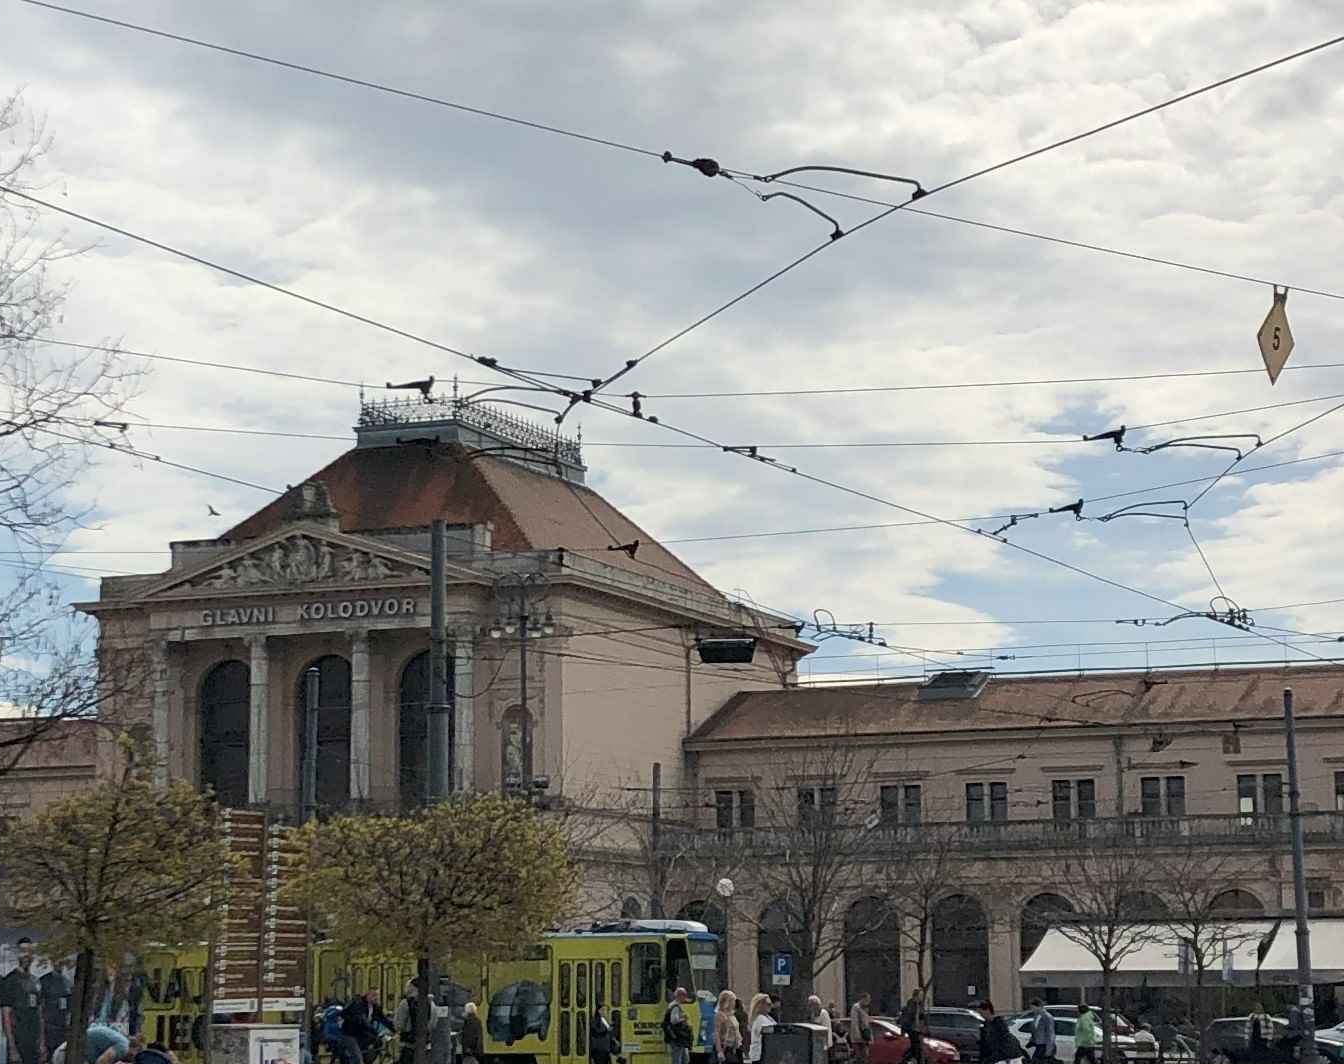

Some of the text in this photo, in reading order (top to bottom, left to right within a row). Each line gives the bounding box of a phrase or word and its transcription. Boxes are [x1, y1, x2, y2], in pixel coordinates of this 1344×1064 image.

[1272, 326, 1281, 351] 5
[201, 598, 417, 626] GLAVNI KOLODVOR
[777, 958, 787, 972] P
